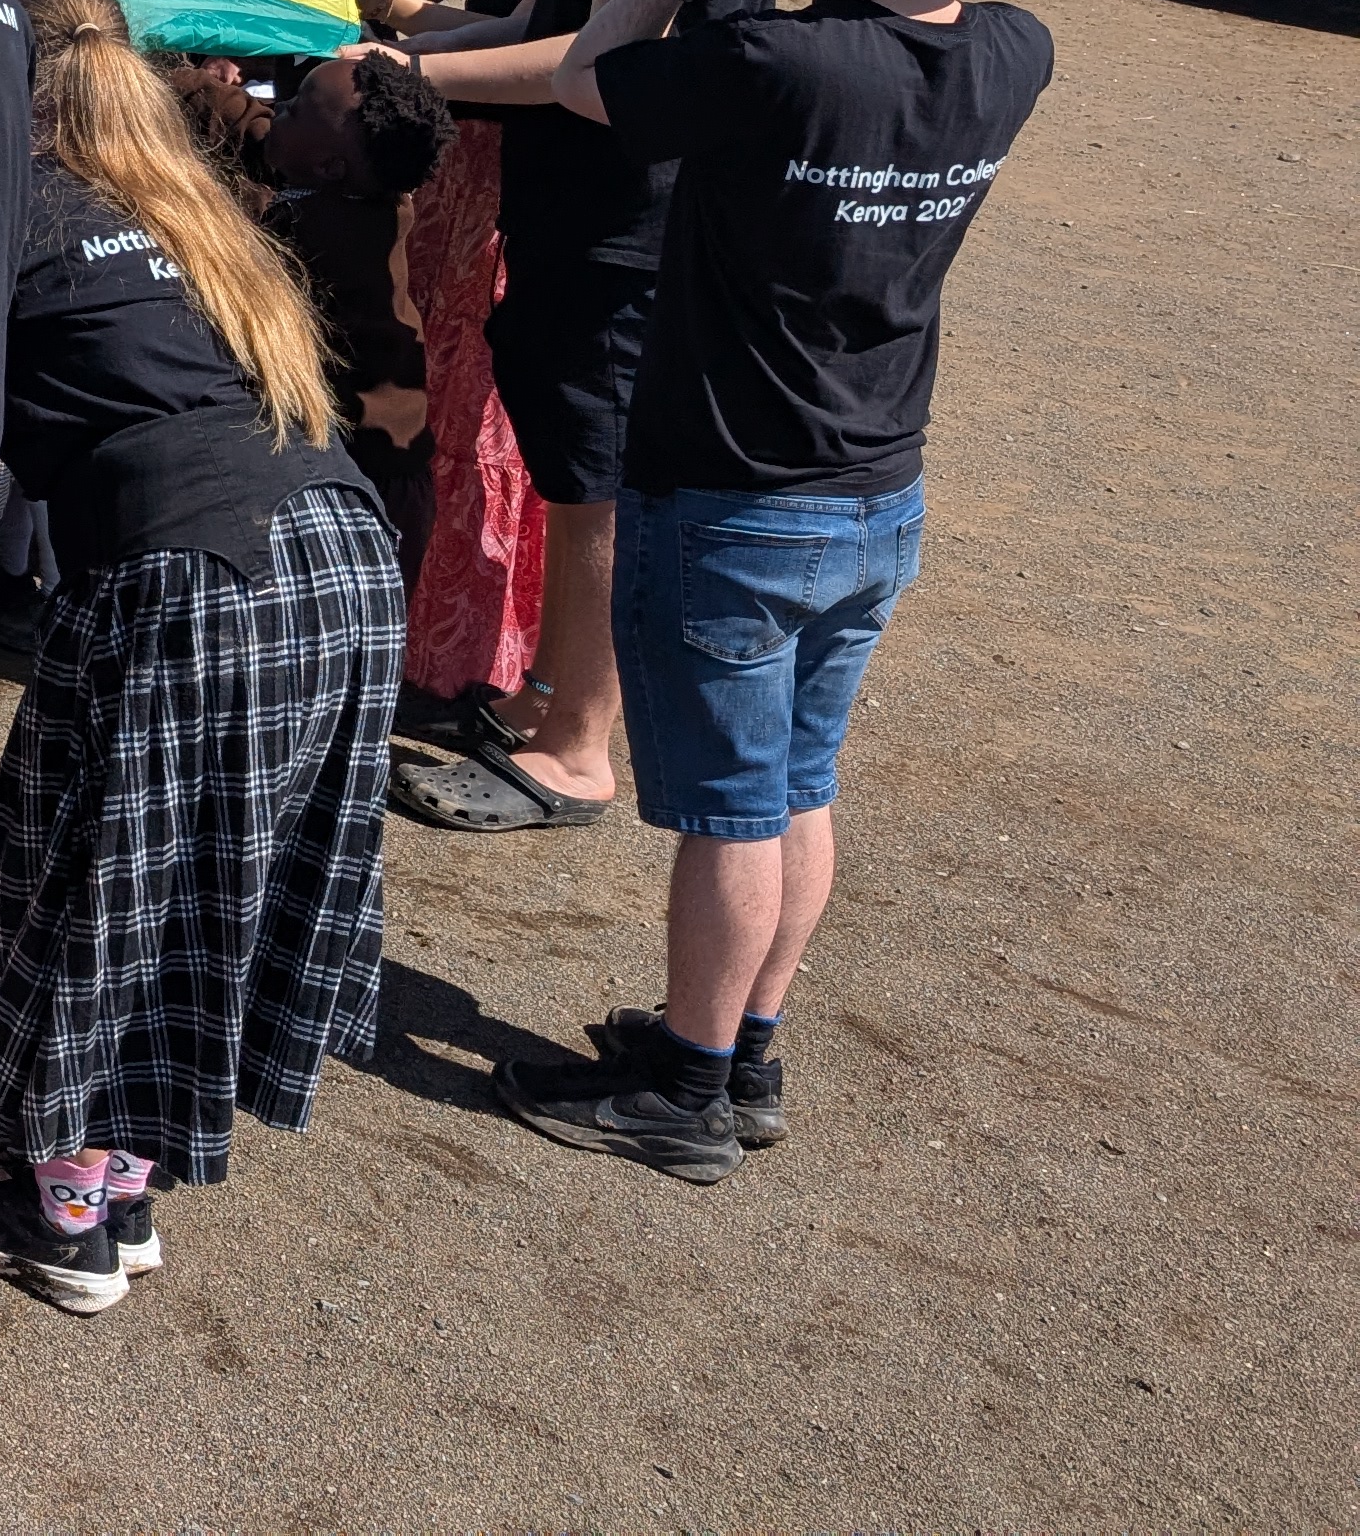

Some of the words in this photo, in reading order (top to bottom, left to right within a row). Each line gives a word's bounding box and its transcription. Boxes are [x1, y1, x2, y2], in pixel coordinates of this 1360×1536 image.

[785, 160, 940, 193] Nottingham
[834, 200, 909, 227] Kenya
[916, 192, 975, 222] 202
